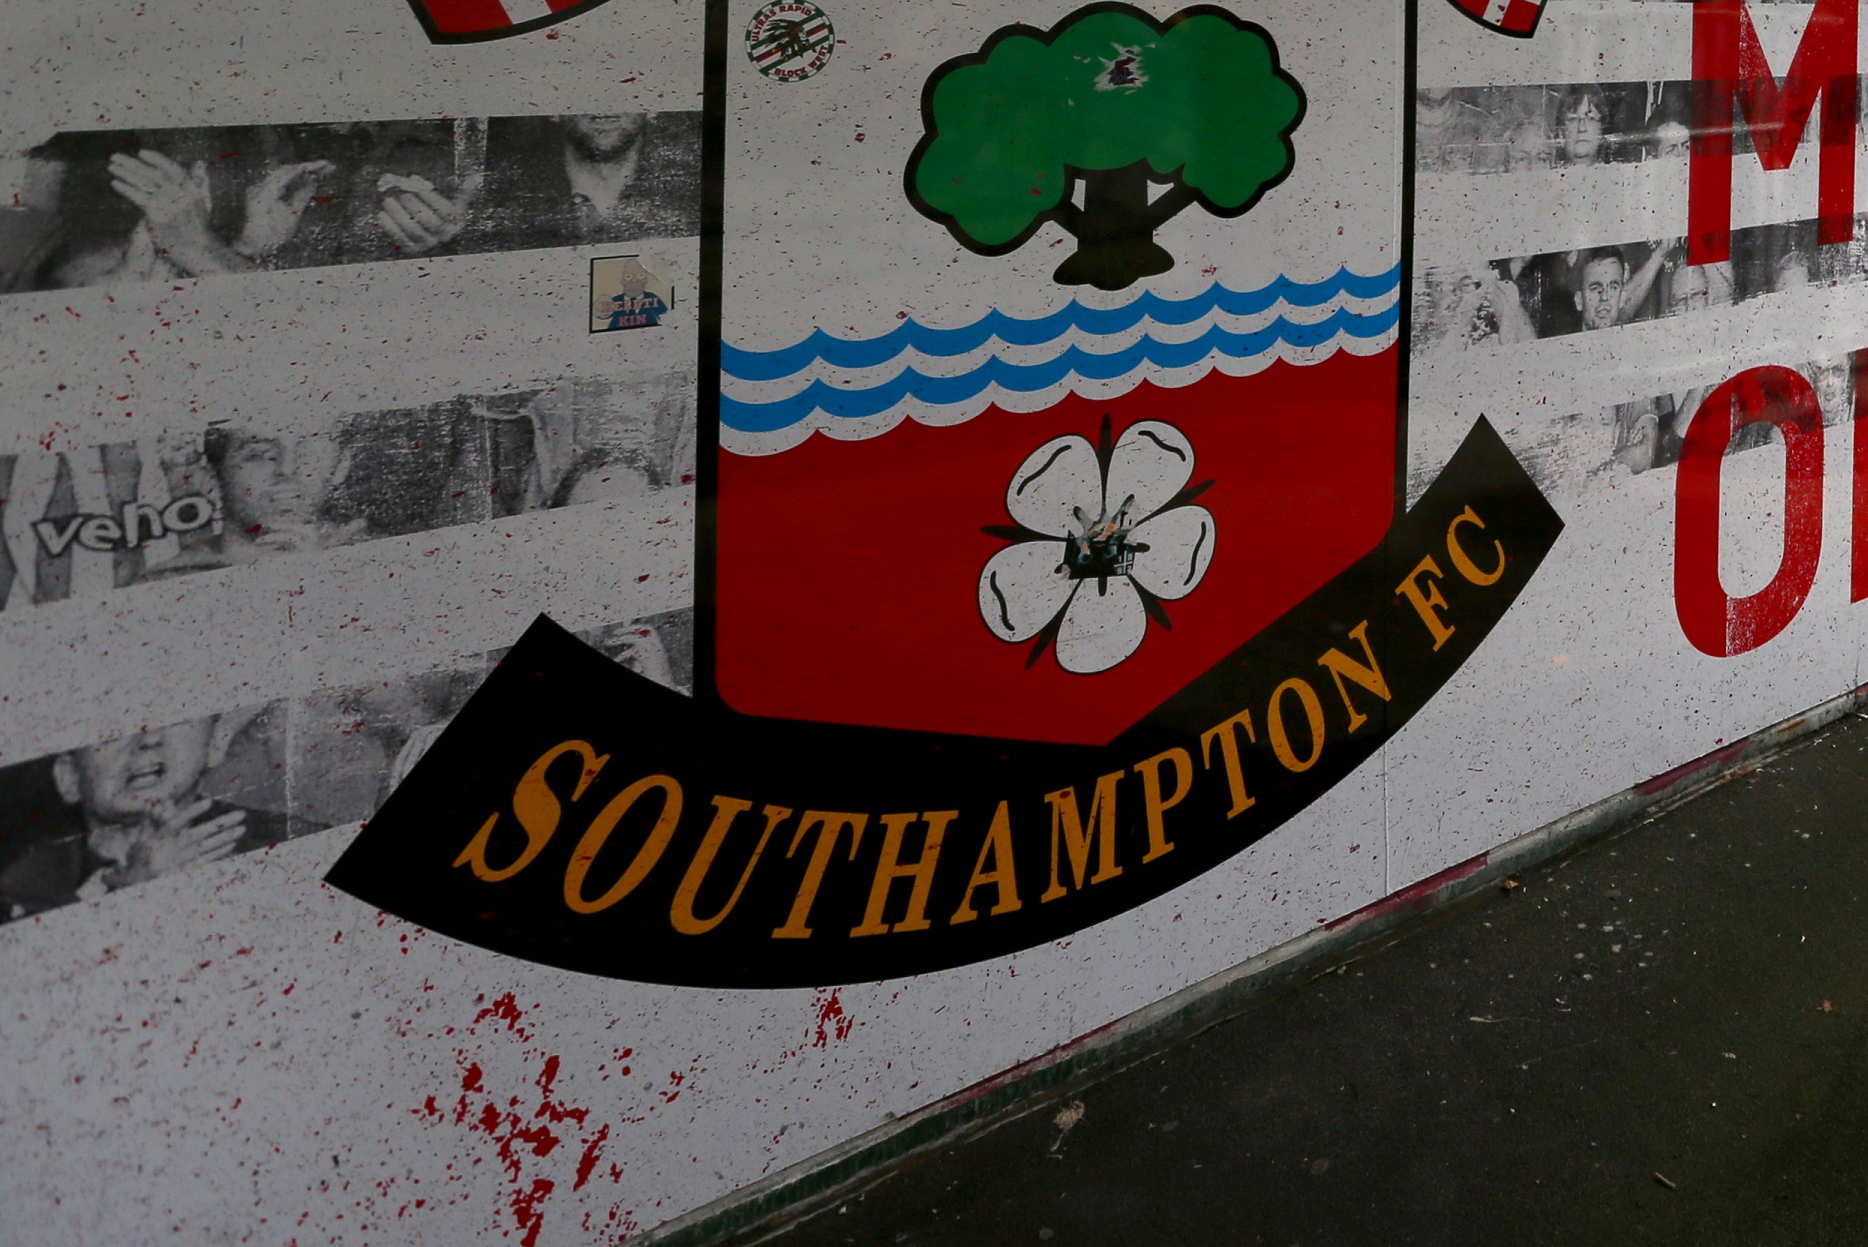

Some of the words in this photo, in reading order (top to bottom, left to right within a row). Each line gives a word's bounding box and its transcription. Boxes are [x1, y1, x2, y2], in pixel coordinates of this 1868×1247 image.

[752, 9, 777, 42] ULTRAS
[779, 5, 812, 16] RAPID
[774, 66, 808, 77] BLOCK
[808, 44, 828, 69] WEST
[453, 621, 1392, 940] SOUTHAMPTON
[1395, 505, 1506, 651] FC
